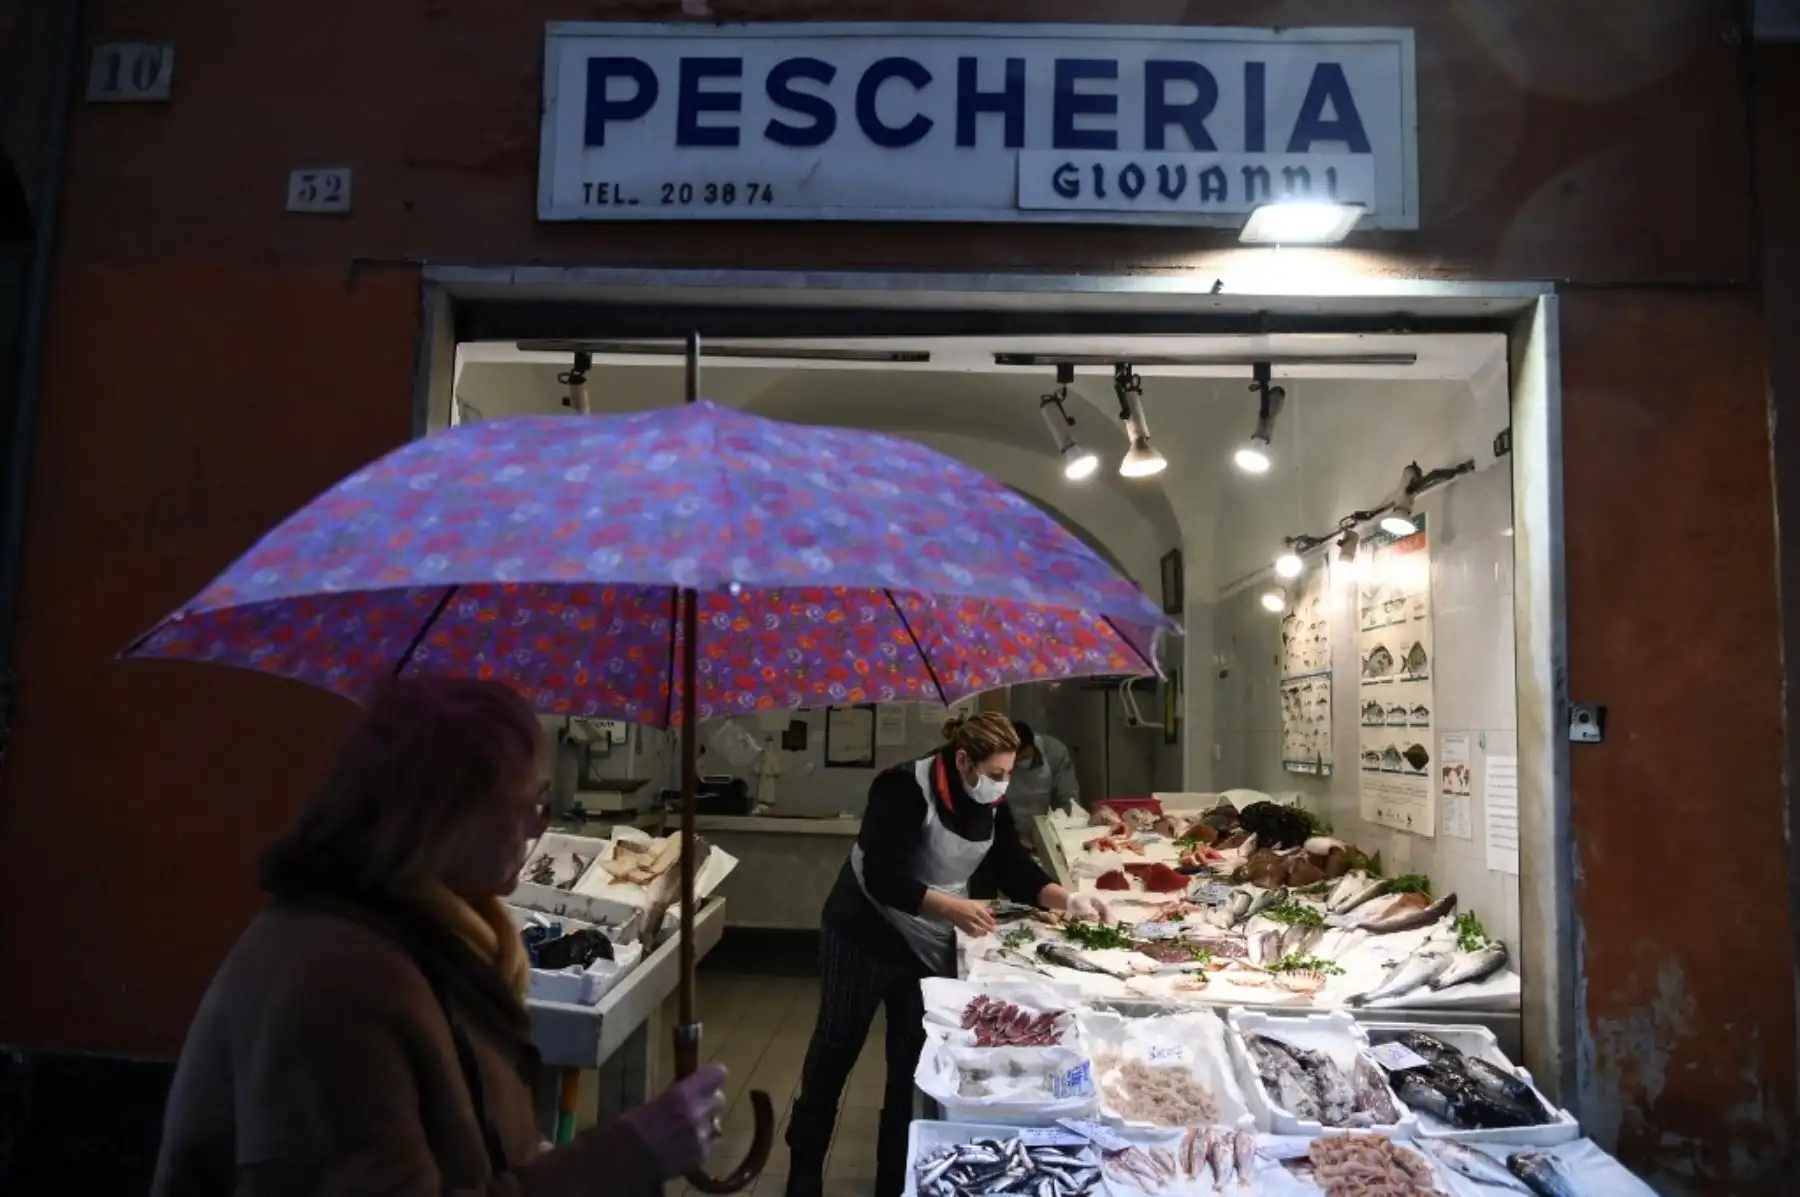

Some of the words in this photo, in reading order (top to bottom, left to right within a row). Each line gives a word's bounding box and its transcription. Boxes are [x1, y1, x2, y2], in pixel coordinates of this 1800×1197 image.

[101, 52, 160, 92] 10
[583, 56, 1373, 153] PESCHERIA
[660, 182, 694, 206] 20
[703, 182, 737, 206] 38
[746, 182, 775, 206] 74
[1052, 162, 1340, 203] GIOVANNI
